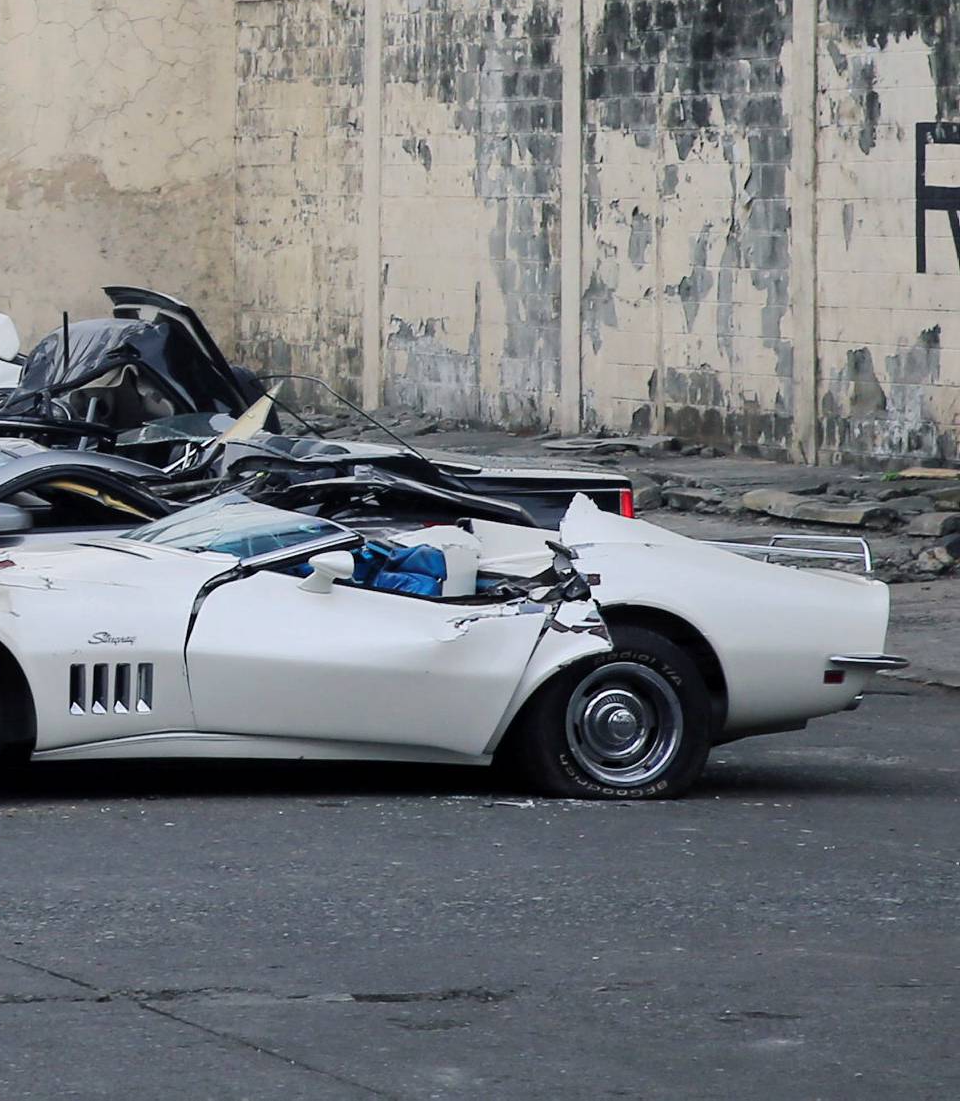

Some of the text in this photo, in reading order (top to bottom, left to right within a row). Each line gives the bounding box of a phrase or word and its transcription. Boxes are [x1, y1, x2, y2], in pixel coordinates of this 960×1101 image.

[87, 631, 137, 646] Stingray
[660, 663, 684, 687] T/A
[558, 753, 669, 798] BFGoodrich
